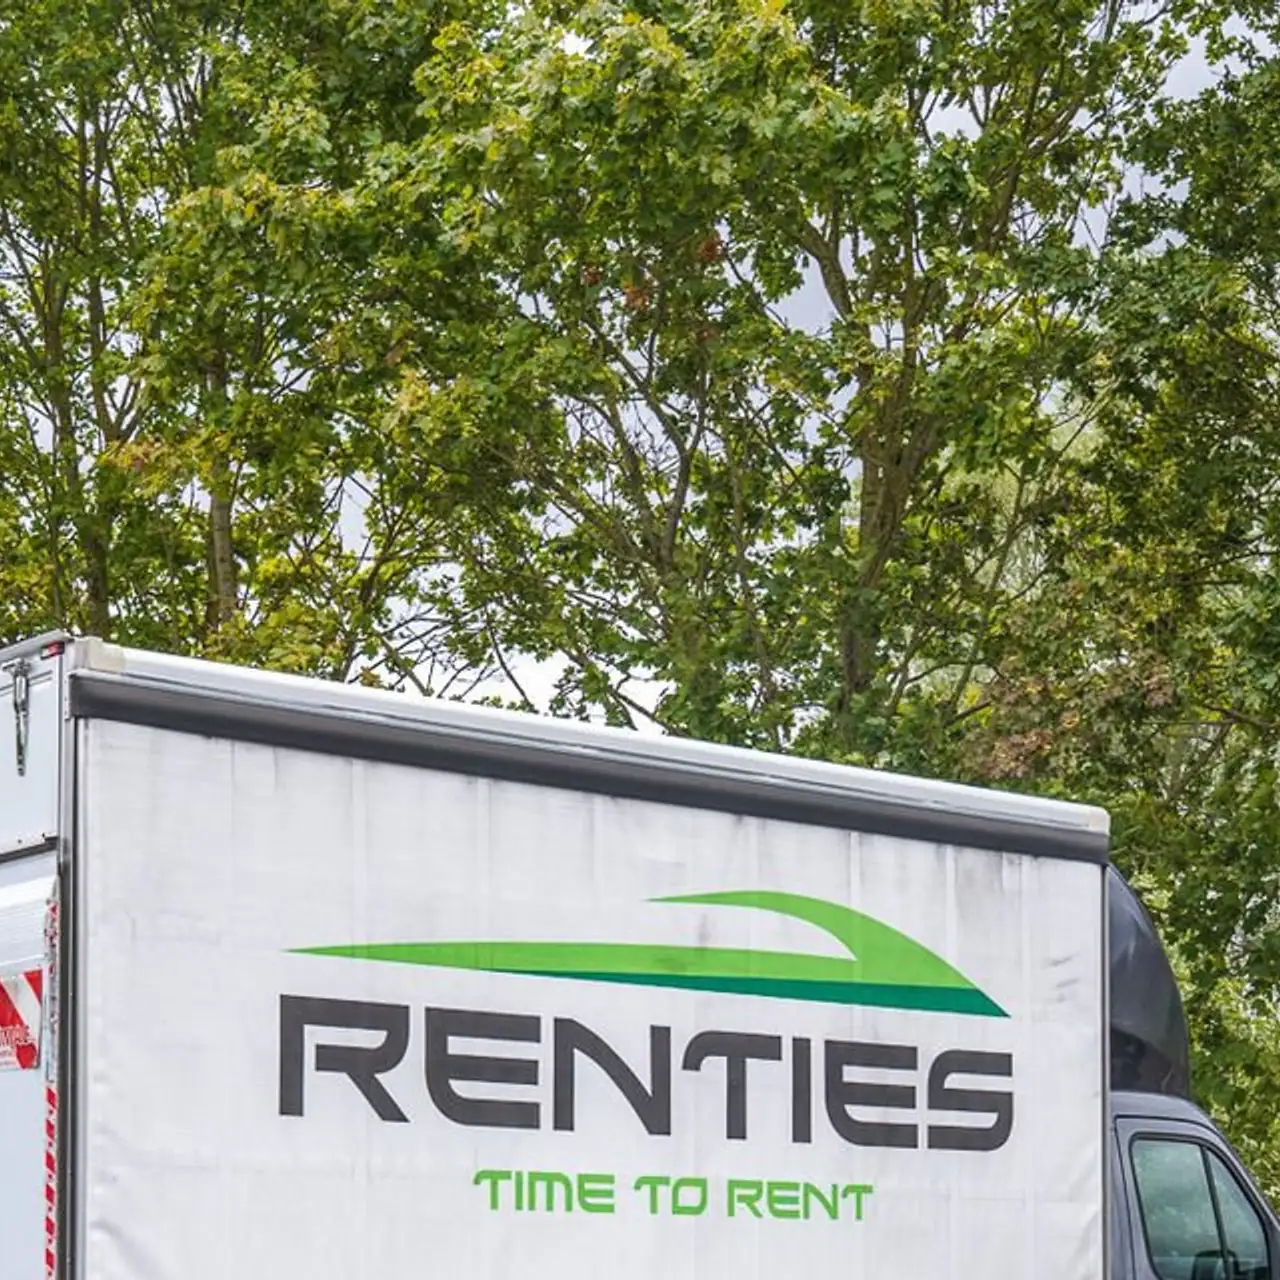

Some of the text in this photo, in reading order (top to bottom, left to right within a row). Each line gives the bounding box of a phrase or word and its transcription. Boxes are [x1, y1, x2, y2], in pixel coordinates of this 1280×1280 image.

[279, 994, 1014, 1152] RENTIES
[473, 1169, 874, 1222] TIME TO RENT
